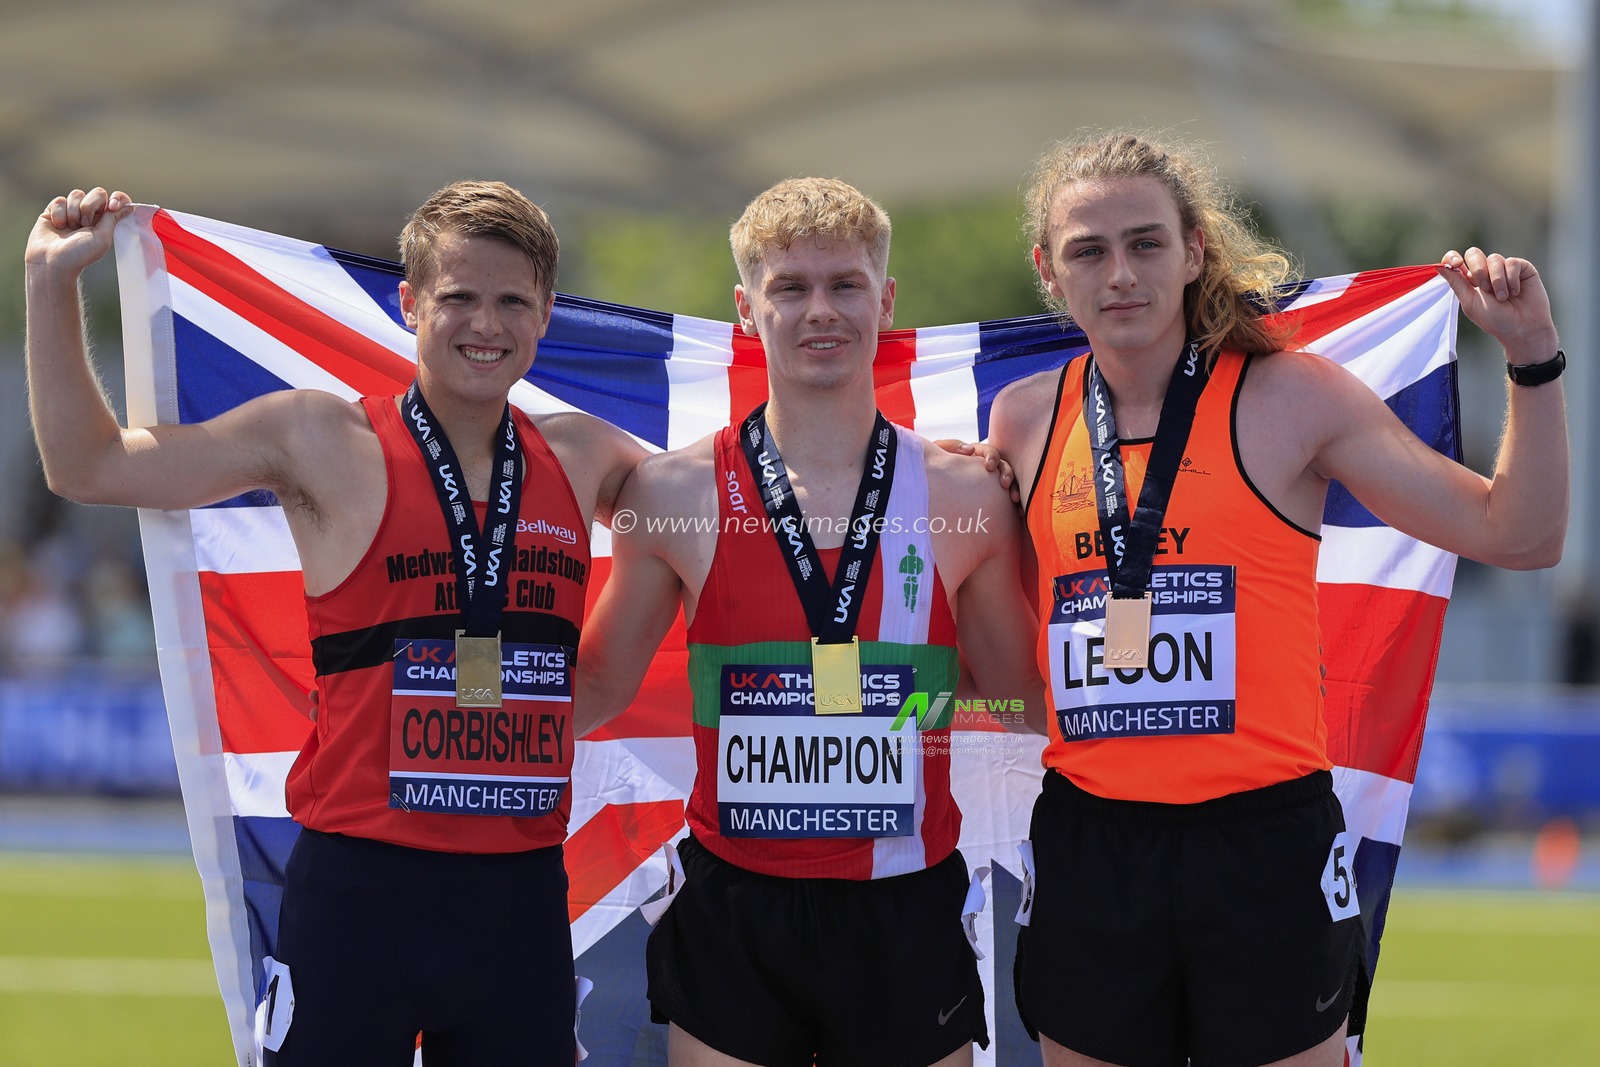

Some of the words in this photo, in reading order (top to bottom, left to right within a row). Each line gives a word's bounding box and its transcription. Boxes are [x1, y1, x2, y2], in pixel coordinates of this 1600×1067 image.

[1183, 343, 1199, 377] UKA
[1094, 384, 1106, 424] UKA
[411, 403, 432, 441] UKA
[757, 450, 778, 487] UKA
[871, 448, 888, 480] UKA
[1100, 452, 1116, 493] UKA
[438, 464, 460, 502] UKA
[497, 480, 513, 514] UKA
[725, 469, 748, 515] soar
[515, 518, 577, 545] Bellway
[1074, 527, 1191, 560] BEEY
[386, 548, 456, 583] Medwa
[460, 533, 477, 577] UKA
[484, 547, 502, 587] UKA
[516, 579, 556, 611] Club
[833, 584, 855, 624] UKA
[1059, 581, 1086, 598] UK
[1061, 590, 1223, 615] CHAMNSHIPS
[406, 646, 442, 663] UK
[446, 647, 565, 668] LETICS
[1109, 648, 1143, 661] UKA
[406, 666, 565, 686] CHANSHIPS
[730, 672, 757, 689] UK
[761, 673, 900, 690] ATHICS
[461, 687, 496, 701] UKA
[402, 707, 566, 764] CORBISHLEY
[1065, 706, 1220, 737] MANCHESTER
[726, 734, 903, 785] CHAMPION
[404, 783, 558, 811] MANCHESTER
[730, 808, 898, 832] MANCHESTER
[1333, 845, 1350, 908] 5
